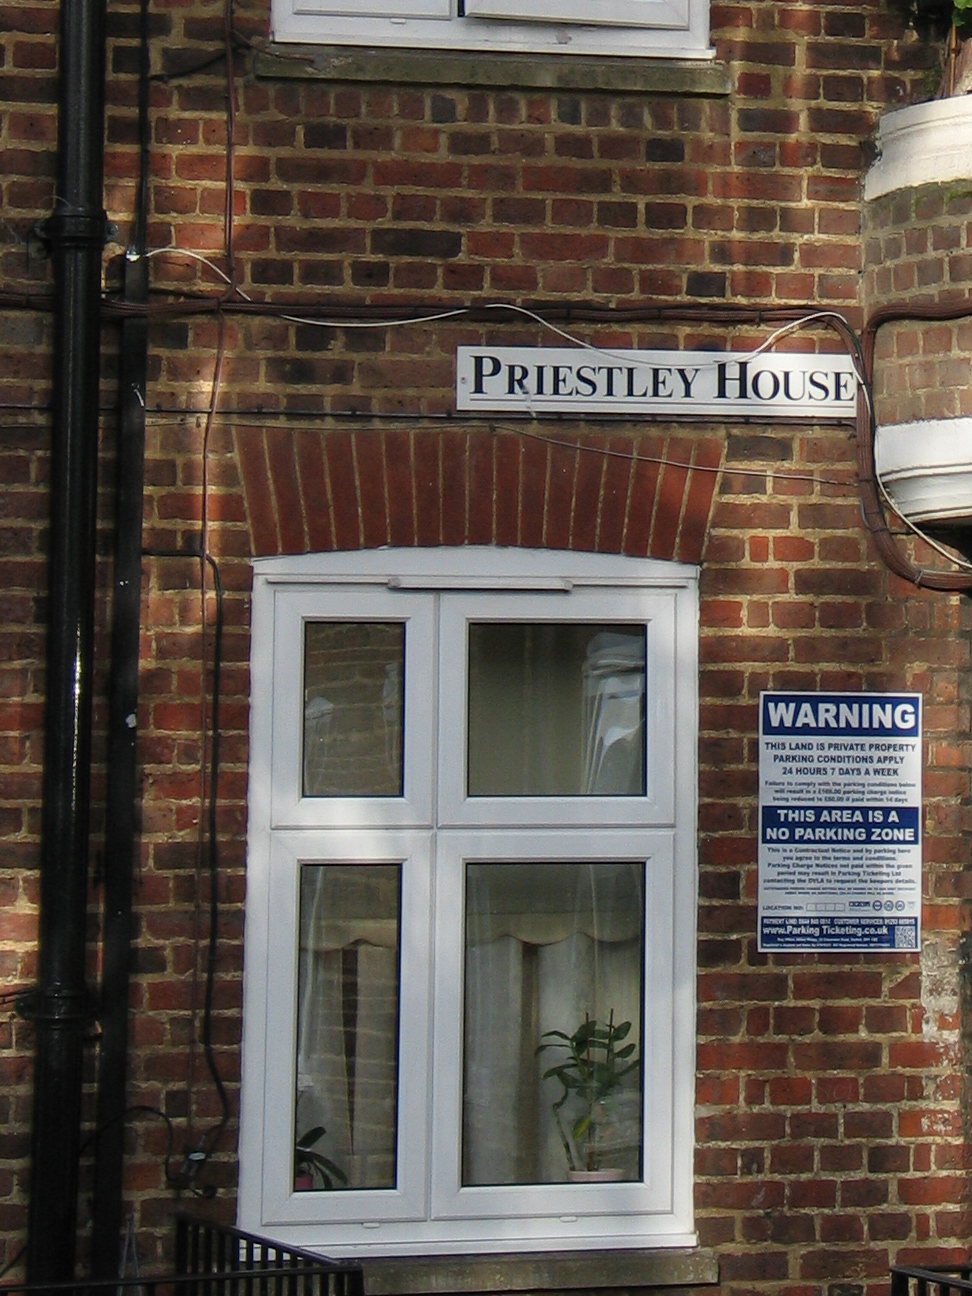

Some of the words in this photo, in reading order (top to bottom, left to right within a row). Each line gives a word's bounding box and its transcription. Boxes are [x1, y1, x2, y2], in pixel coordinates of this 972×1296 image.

[469, 354, 700, 400] PRIESTLEY
[713, 360, 855, 402] HOUSE
[768, 702, 915, 729] WARNING
[765, 742, 786, 750] THIS
[789, 742, 813, 751] LAND
[816, 743, 825, 751] IS
[828, 743, 865, 752] PRIVATE
[868, 743, 916, 752] PROPERTY
[817, 756, 874, 764] CONDITIONS
[876, 756, 905, 764] APPLY
[864, 768, 870, 776] A
[873, 768, 899, 776] WEEK
[777, 810, 815, 822] THIS
[820, 810, 863, 823] AREA
[868, 810, 883, 823] IS
[887, 810, 899, 823] A
[766, 828, 790, 840] NO
[795, 828, 866, 840] PARKING
[871, 828, 915, 841] ZONE
[763, 925, 819, 936] www.Parking
[822, 925, 888, 936] Ticketing.co.uk
